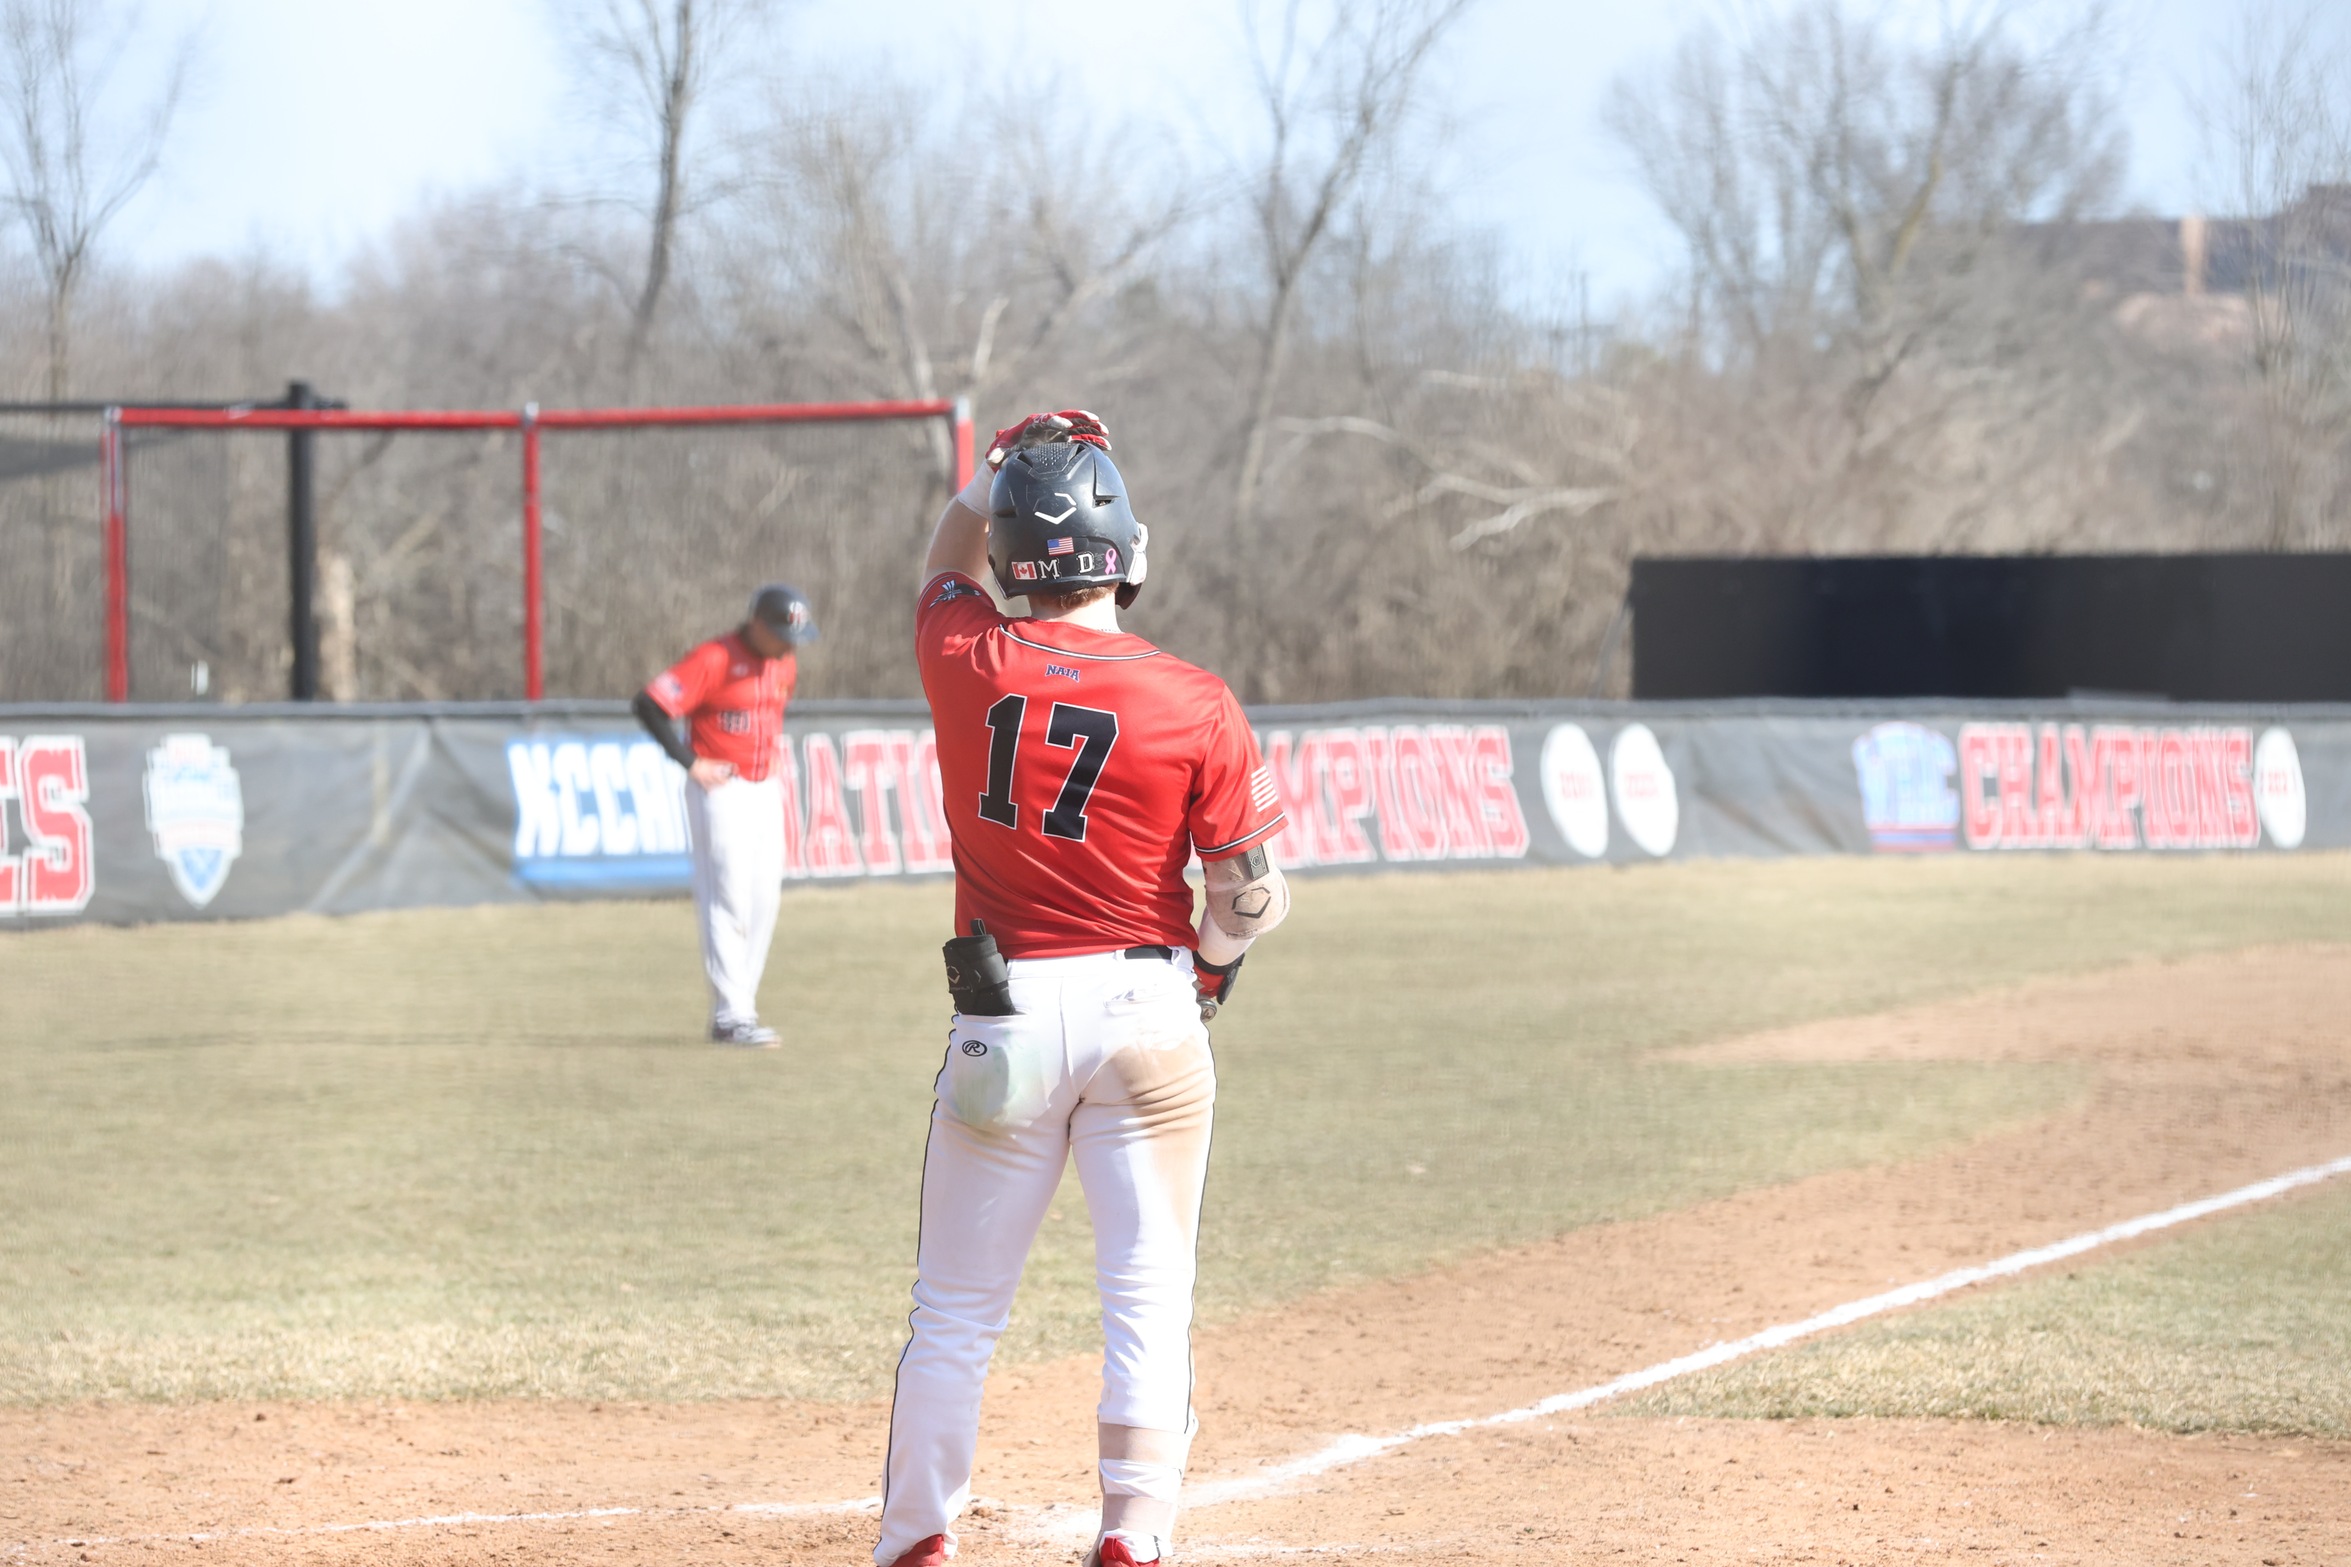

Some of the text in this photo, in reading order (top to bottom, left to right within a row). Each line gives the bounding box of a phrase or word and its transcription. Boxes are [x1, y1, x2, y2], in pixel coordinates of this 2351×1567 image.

[1039, 553, 1095, 579] M D
[1045, 664, 1080, 683] NAIA
[978, 693, 1119, 842] 17
[1958, 722, 2260, 850] CHAMPIONS
